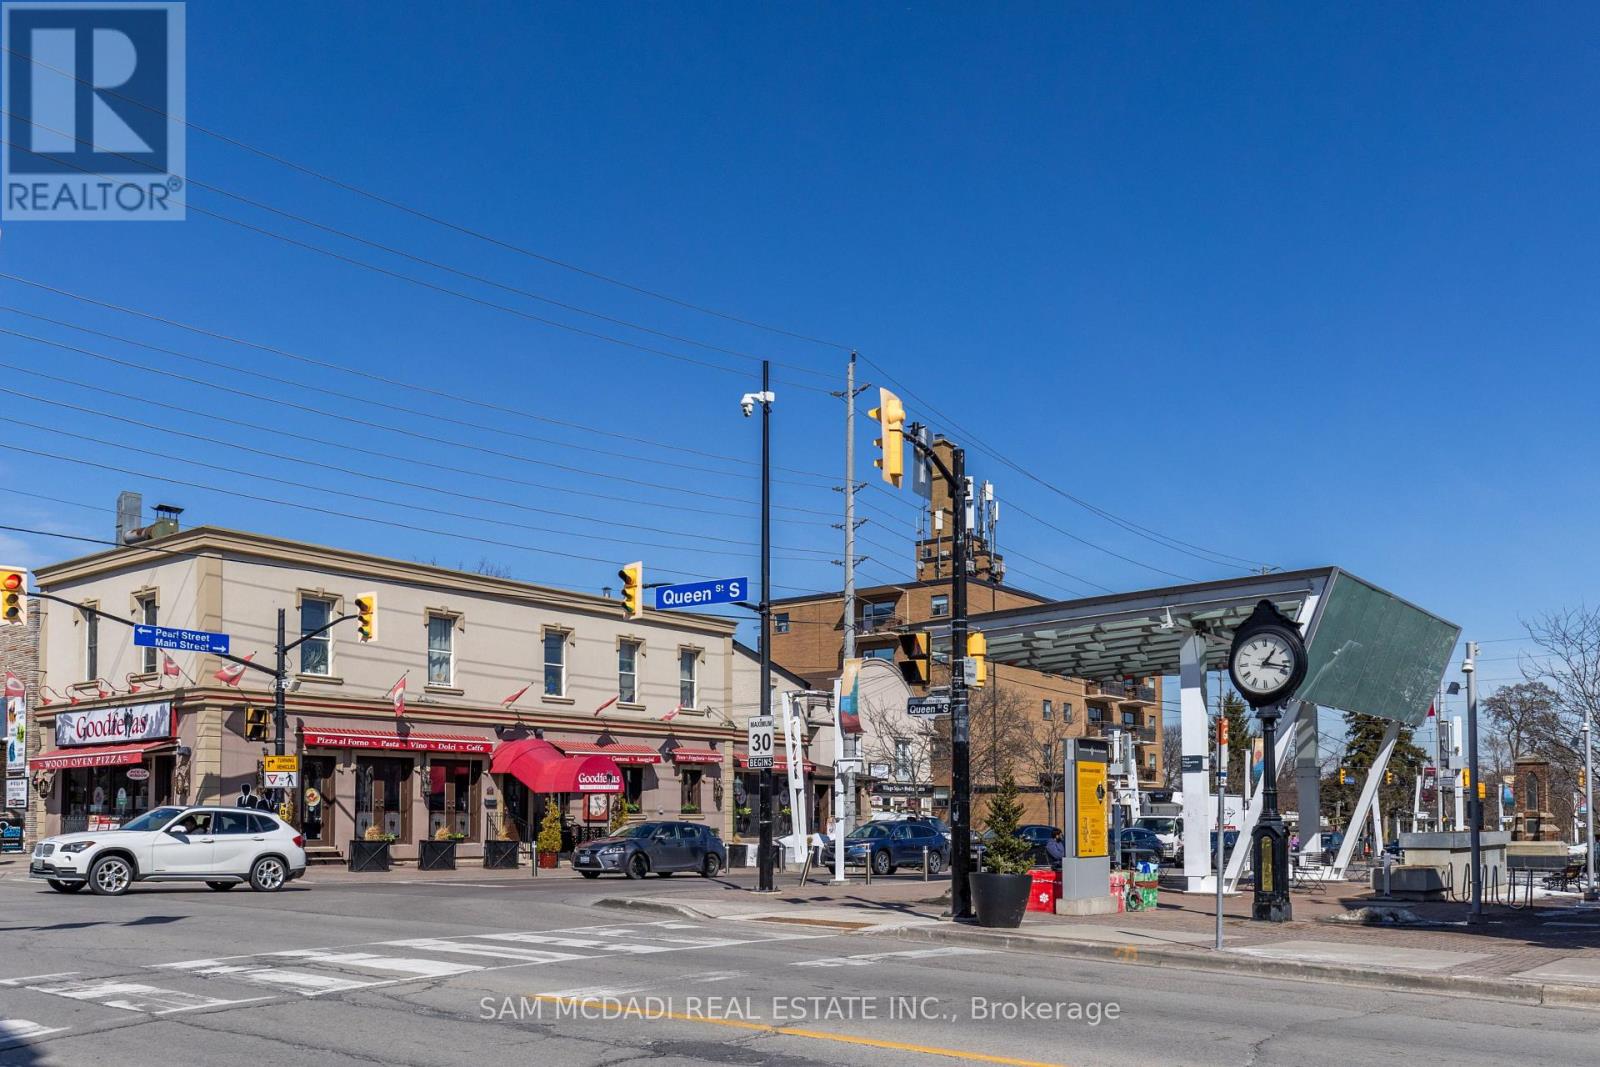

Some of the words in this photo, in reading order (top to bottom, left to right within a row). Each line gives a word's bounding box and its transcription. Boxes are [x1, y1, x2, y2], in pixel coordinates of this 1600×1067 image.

[663, 589, 712, 605] Queen
[715, 584, 724, 593] St
[729, 582, 740, 598] S
[155, 628, 179, 639] Pearl
[181, 631, 210, 642] Street
[155, 638, 177, 648] Main
[179, 640, 209, 651] Street
[909, 705, 936, 714] Queen
[942, 704, 949, 713] S
[750, 720, 773, 728] MAXIMUM
[316, 736, 337, 744] Pizza
[381, 740, 400, 748] Pasta
[752, 733, 771, 751] 30
[44, 759, 68, 768] WOOD
[71, 757, 92, 767] OVEN
[96, 755, 123, 765] PIZZA
[749, 758, 773, 767] BEGINS
